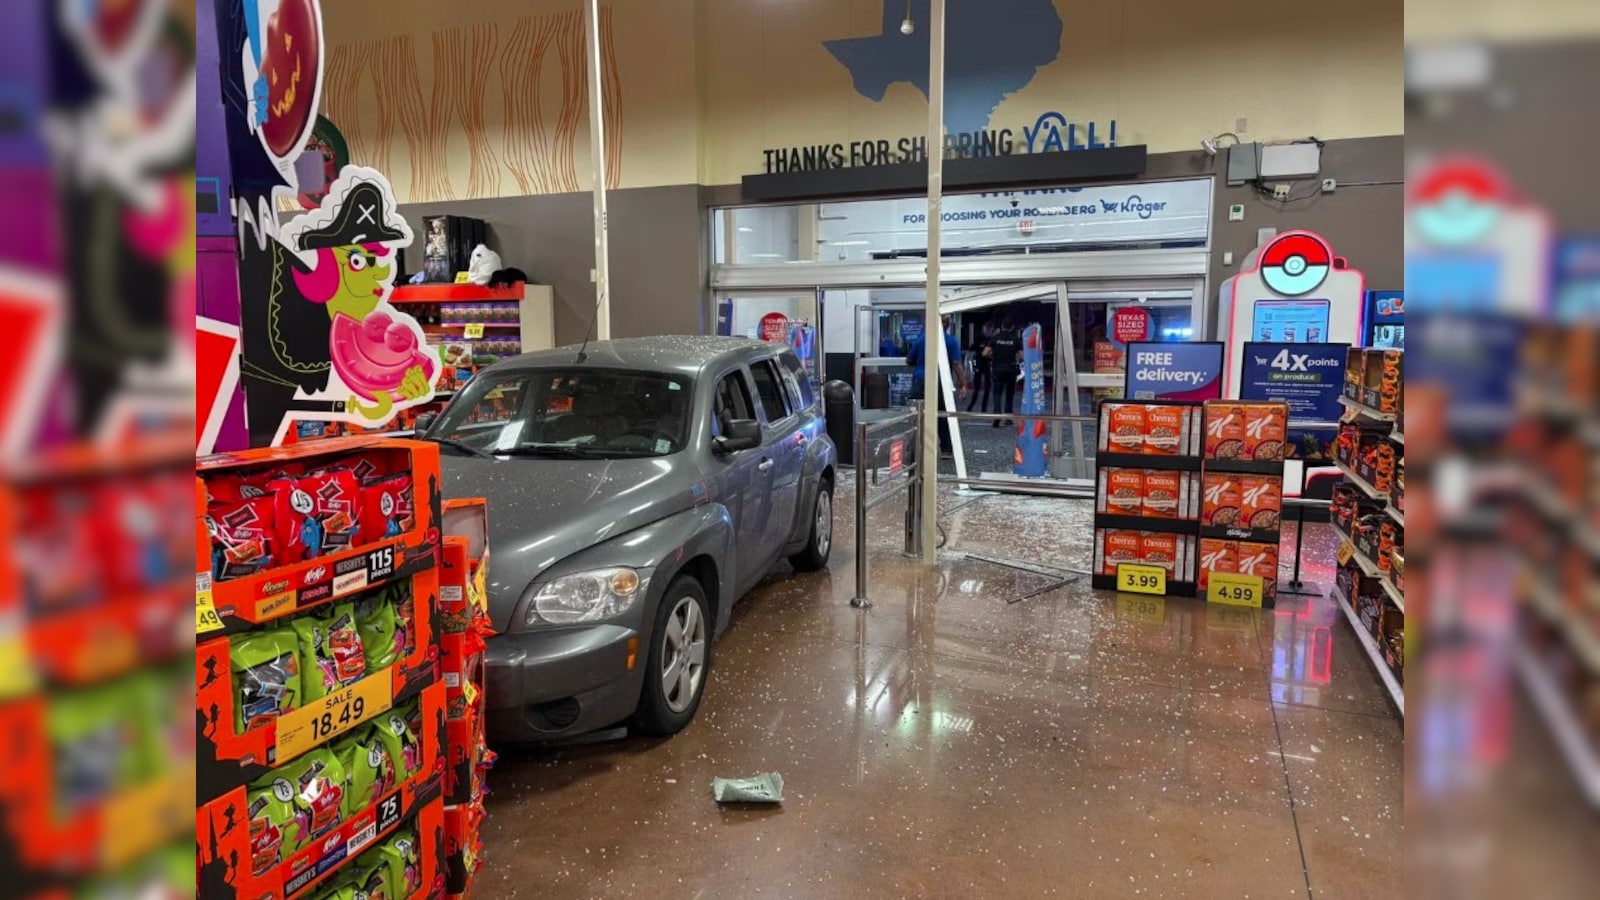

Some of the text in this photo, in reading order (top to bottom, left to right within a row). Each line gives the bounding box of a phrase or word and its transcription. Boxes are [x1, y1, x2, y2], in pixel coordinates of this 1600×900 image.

[763, 111, 1117, 174] THANKS FOR SHPPING Y'ALL!
[903, 195, 1167, 223] FOR OOSING YOUR ROBERG Kroger
[1117, 321, 1145, 329] SIZED
[1136, 352, 1173, 365] FREE
[1307, 358, 1339, 367] points
[1207, 413, 1234, 439] K
[1246, 413, 1273, 440] K
[1204, 481, 1231, 506] K
[1242, 483, 1270, 508] K
[335, 556, 366, 574] HERSHEY'S
[370, 548, 393, 570] 115
[1201, 549, 1227, 572] K
[1239, 552, 1266, 576] K
[370, 567, 392, 580] pieces
[1127, 574, 1158, 588] 3.99
[1218, 586, 1253, 600] 4.99
[325, 689, 353, 709] SALE
[311, 696, 364, 740] 18.49
[381, 795, 397, 820] 75
[379, 814, 399, 832] pieces
[349, 825, 375, 849] HERSHEY'S
[285, 866, 316, 896] HERSHEY'S
